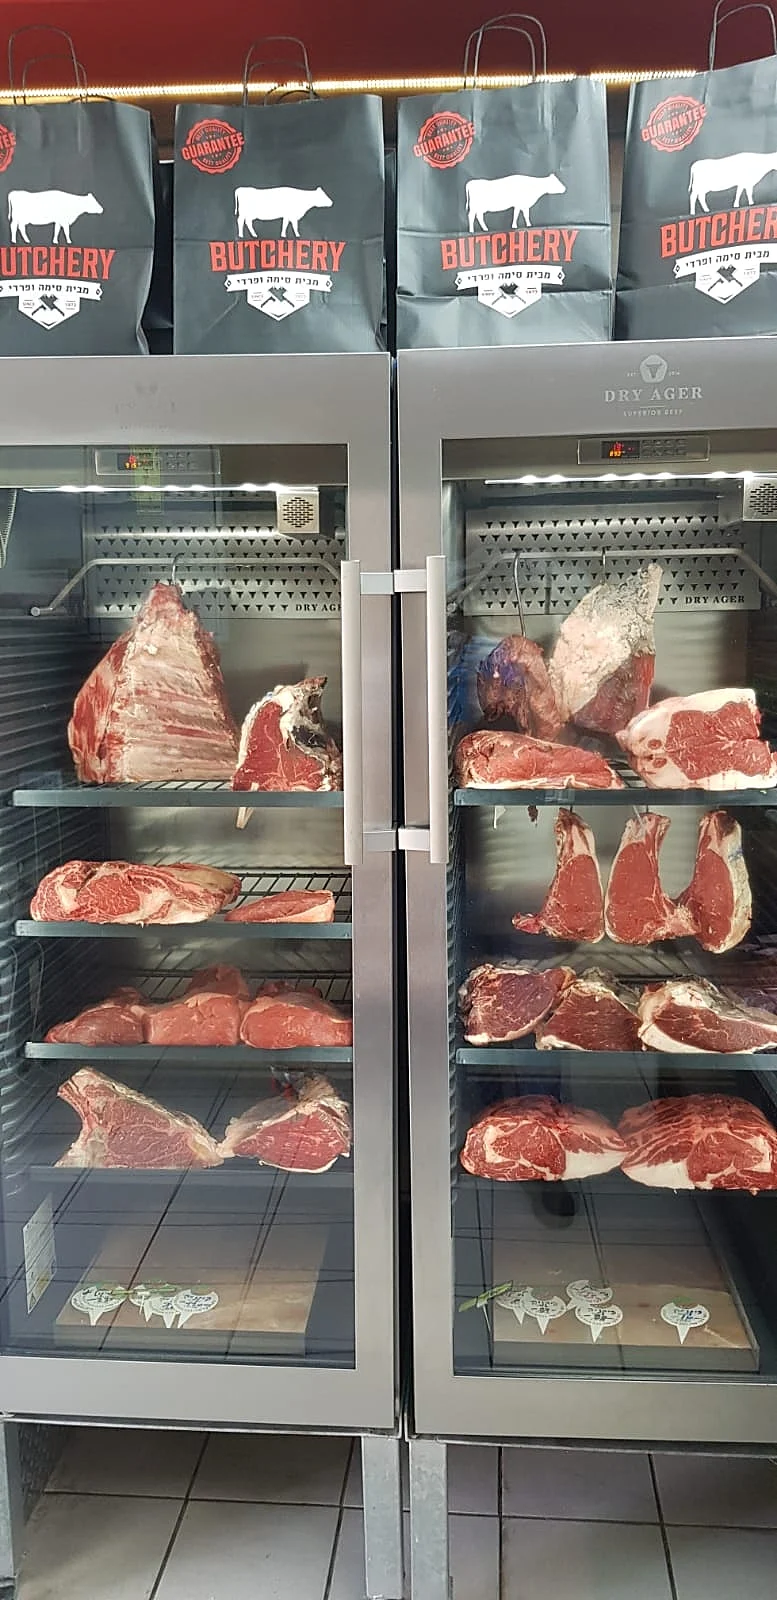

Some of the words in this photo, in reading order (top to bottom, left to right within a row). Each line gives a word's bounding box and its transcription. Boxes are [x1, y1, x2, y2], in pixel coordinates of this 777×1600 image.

[641, 104, 707, 142] GUARANTEE
[413, 122, 476, 157] GUARANTEE
[182, 132, 245, 160] GUARANTEE
[660, 206, 777, 259] BUTCHER
[440, 229, 579, 270] BUTCHERY
[209, 240, 346, 272] BUTCHERY
[715, 252, 741, 263] סימה
[744, 250, 770, 260] מבית
[0, 246, 115, 280] UTCHERY
[266, 276, 291, 284] סימה
[498, 271, 523, 280] סימה
[526, 271, 551, 279] מבית
[295, 278, 319, 286] מבית
[38, 284, 62, 292] סימה
[65, 285, 89, 294] מבית
[604, 388, 643, 402] DRY
[650, 386, 704, 401] AGER
[685, 596, 709, 605] DRY
[713, 595, 745, 604] AGER
[295, 603, 318, 612] DRY
[321, 603, 342, 612] AGE
